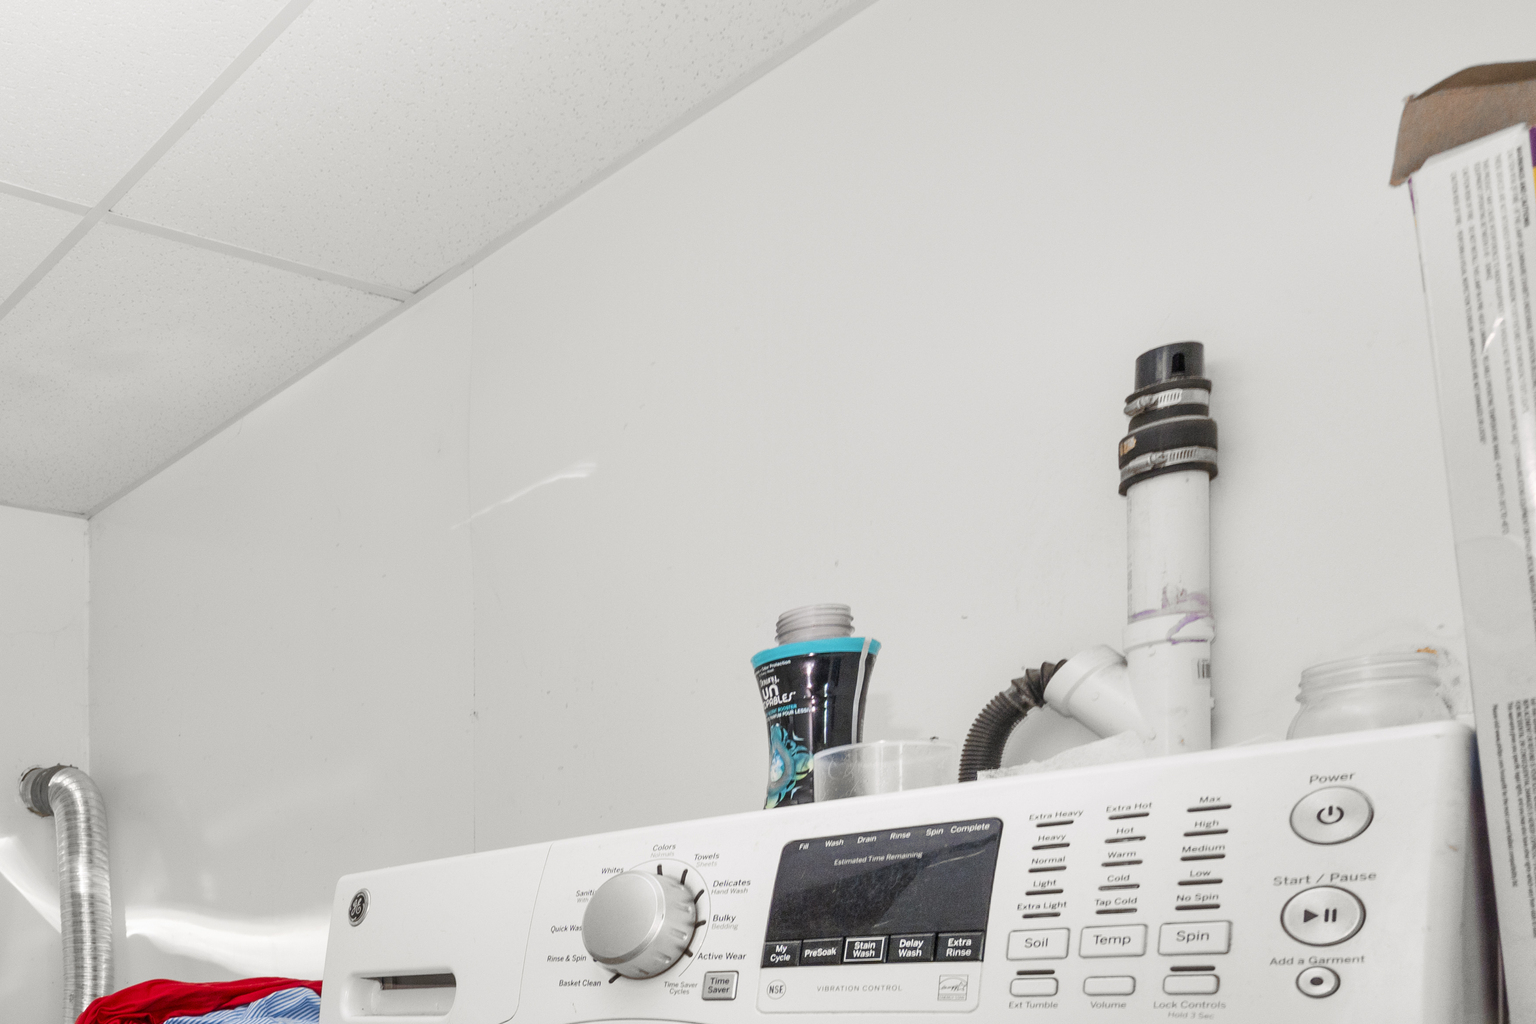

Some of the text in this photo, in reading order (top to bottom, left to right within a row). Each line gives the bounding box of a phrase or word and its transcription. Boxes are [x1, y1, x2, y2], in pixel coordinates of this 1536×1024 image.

[1309, 772, 1356, 785] Power
[1199, 796, 1221, 804] Max
[1106, 802, 1152, 813] Extra Hot
[1029, 809, 1084, 821] Extra Heavy
[950, 822, 990, 834] Complete
[1194, 820, 1219, 829] High
[890, 831, 911, 840] Rinse
[926, 828, 943, 837] Spin
[857, 835, 877, 844] Drain
[1038, 833, 1066, 842] Heavy
[825, 838, 844, 847] Wash
[1181, 844, 1226, 853] Medium
[694, 853, 719, 861] Towels
[834, 851, 923, 866] Estimated Time Remaining
[1107, 850, 1137, 859] Warm
[1031, 856, 1066, 865] Normal
[1189, 869, 1211, 877] Low
[1107, 874, 1130, 882] Cold
[1273, 875, 1311, 887] Start
[1330, 872, 1377, 882] Pause
[713, 879, 751, 887] Delicates
[1033, 879, 1056, 888] Light
[1095, 897, 1137, 907] Tap Cold
[1176, 893, 1219, 902] No Spin
[1017, 901, 1067, 911] Extra Light
[713, 914, 736, 923] Bulky
[550, 924, 582, 933] Quick Was
[1093, 935, 1132, 946] Temp
[1176, 930, 1210, 942] Spin
[854, 941, 876, 950] Stain
[899, 939, 924, 949] Delay
[948, 938, 972, 947] Extra
[1024, 938, 1049, 948] Soil
[775, 944, 788, 955] My
[804, 947, 837, 958] PreSoak
[853, 949, 875, 958] Wash
[898, 948, 922, 957] Wash
[945, 947, 972, 957] Rinse
[573, 954, 586, 963] Spin
[698, 952, 746, 960] Active Wear
[770, 952, 790, 962] Cycle
[1270, 956, 1294, 966] Add
[1308, 955, 1365, 966] Garment
[559, 979, 601, 987] Basket Clean
[710, 977, 730, 985] Time
[708, 985, 730, 994] Saver
[862, 984, 902, 992] CONTROL
[1009, 1001, 1058, 1009] Ext Tumble
[1090, 1001, 1127, 1009] Volume
[1153, 1001, 1226, 1009] Lock Controls
